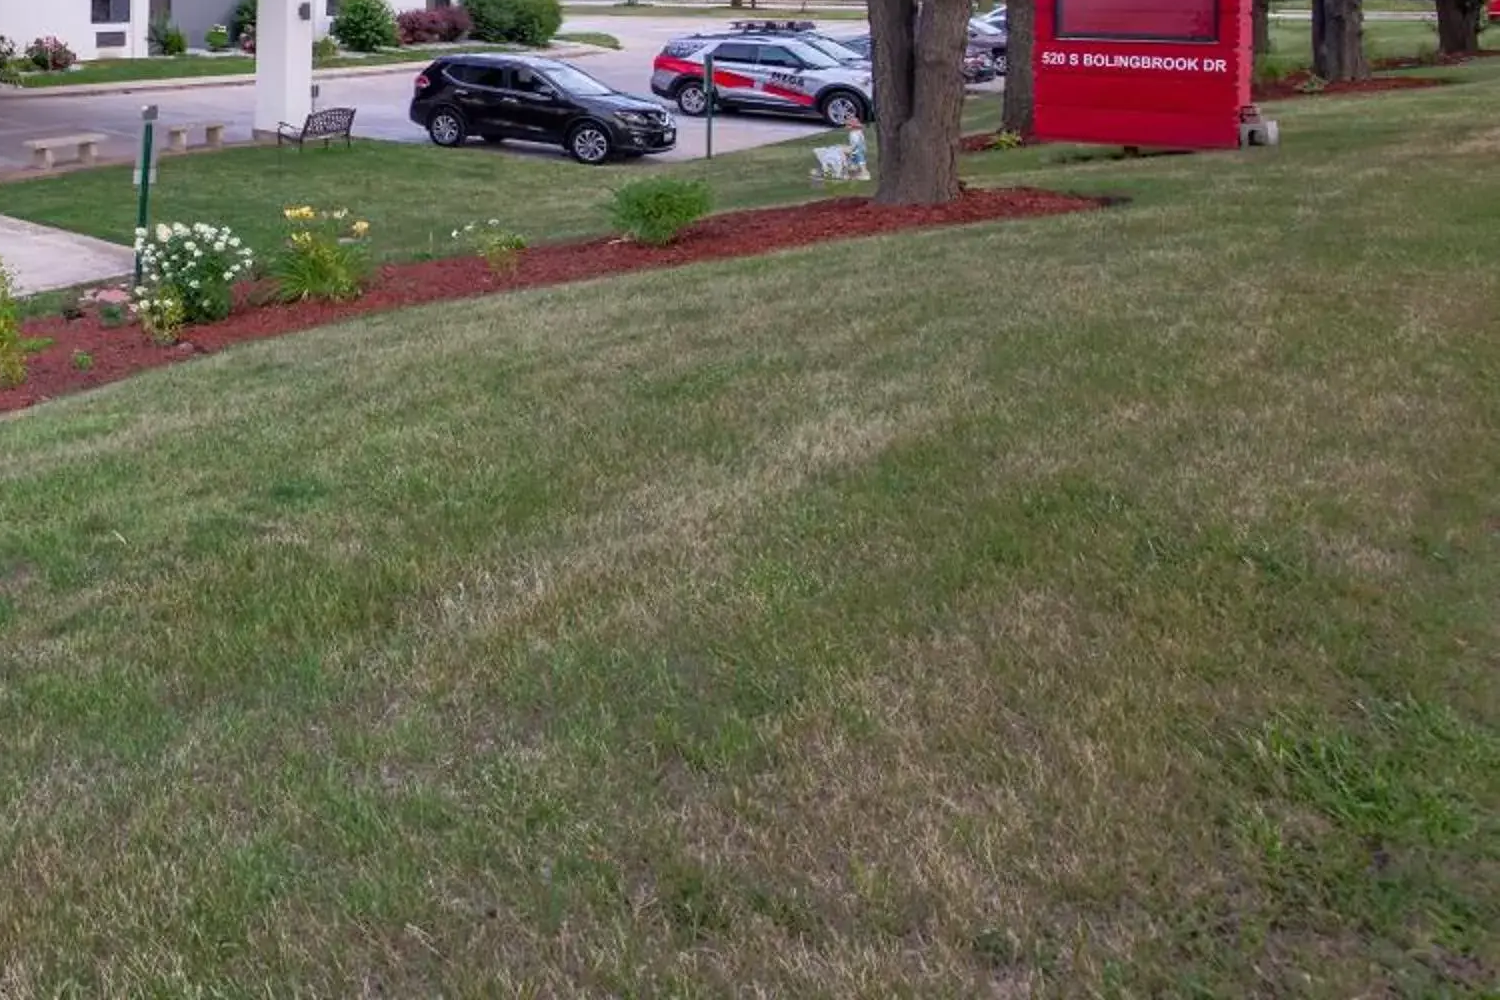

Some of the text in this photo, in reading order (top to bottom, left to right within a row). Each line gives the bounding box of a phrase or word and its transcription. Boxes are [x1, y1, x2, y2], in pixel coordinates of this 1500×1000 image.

[1041, 51, 1227, 73] 520 S BOLINGBROOK DR
